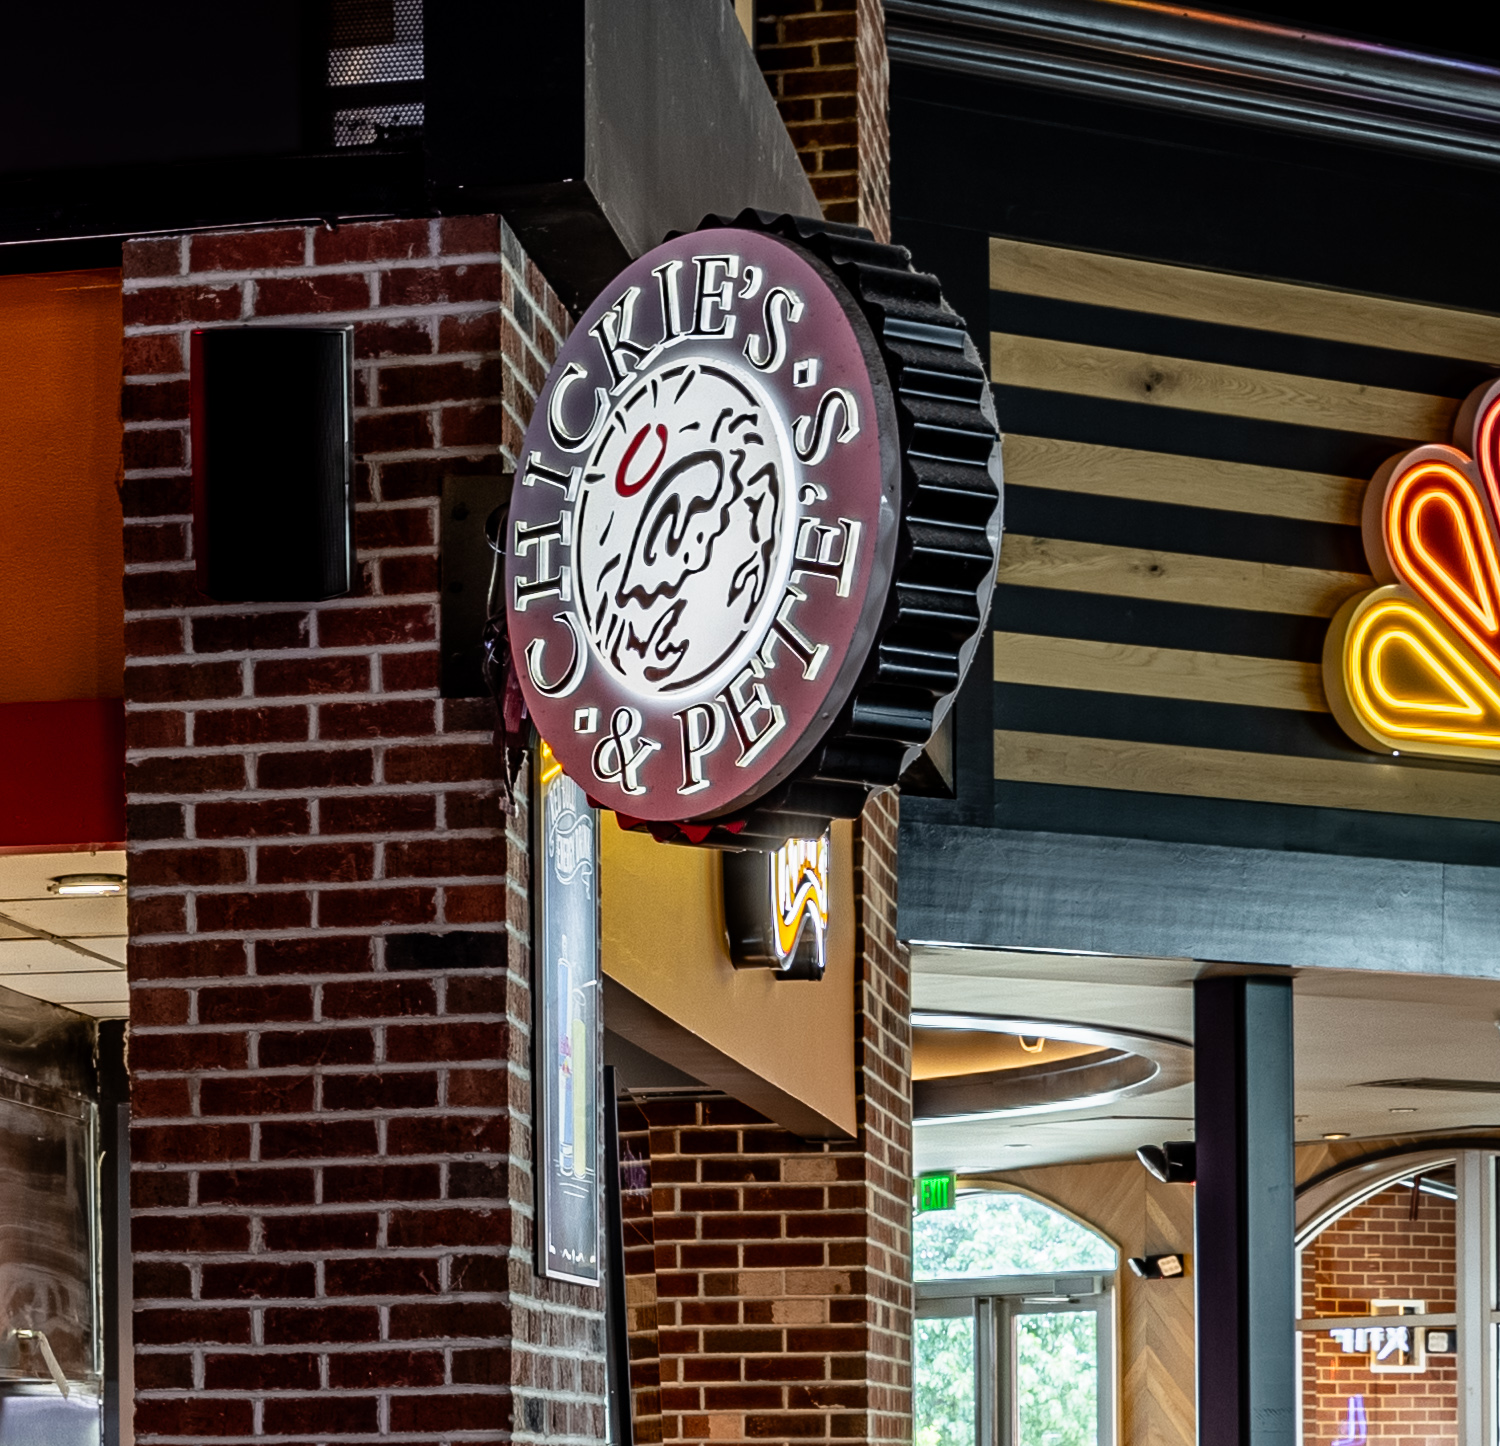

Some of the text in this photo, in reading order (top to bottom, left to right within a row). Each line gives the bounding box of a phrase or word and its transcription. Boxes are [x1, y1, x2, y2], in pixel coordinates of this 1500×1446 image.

[512, 252, 804, 699] CHICKIE'S
[591, 706, 661, 797] &
[676, 387, 863, 797] PETE'S
[921, 1177, 950, 1210] EXIT
